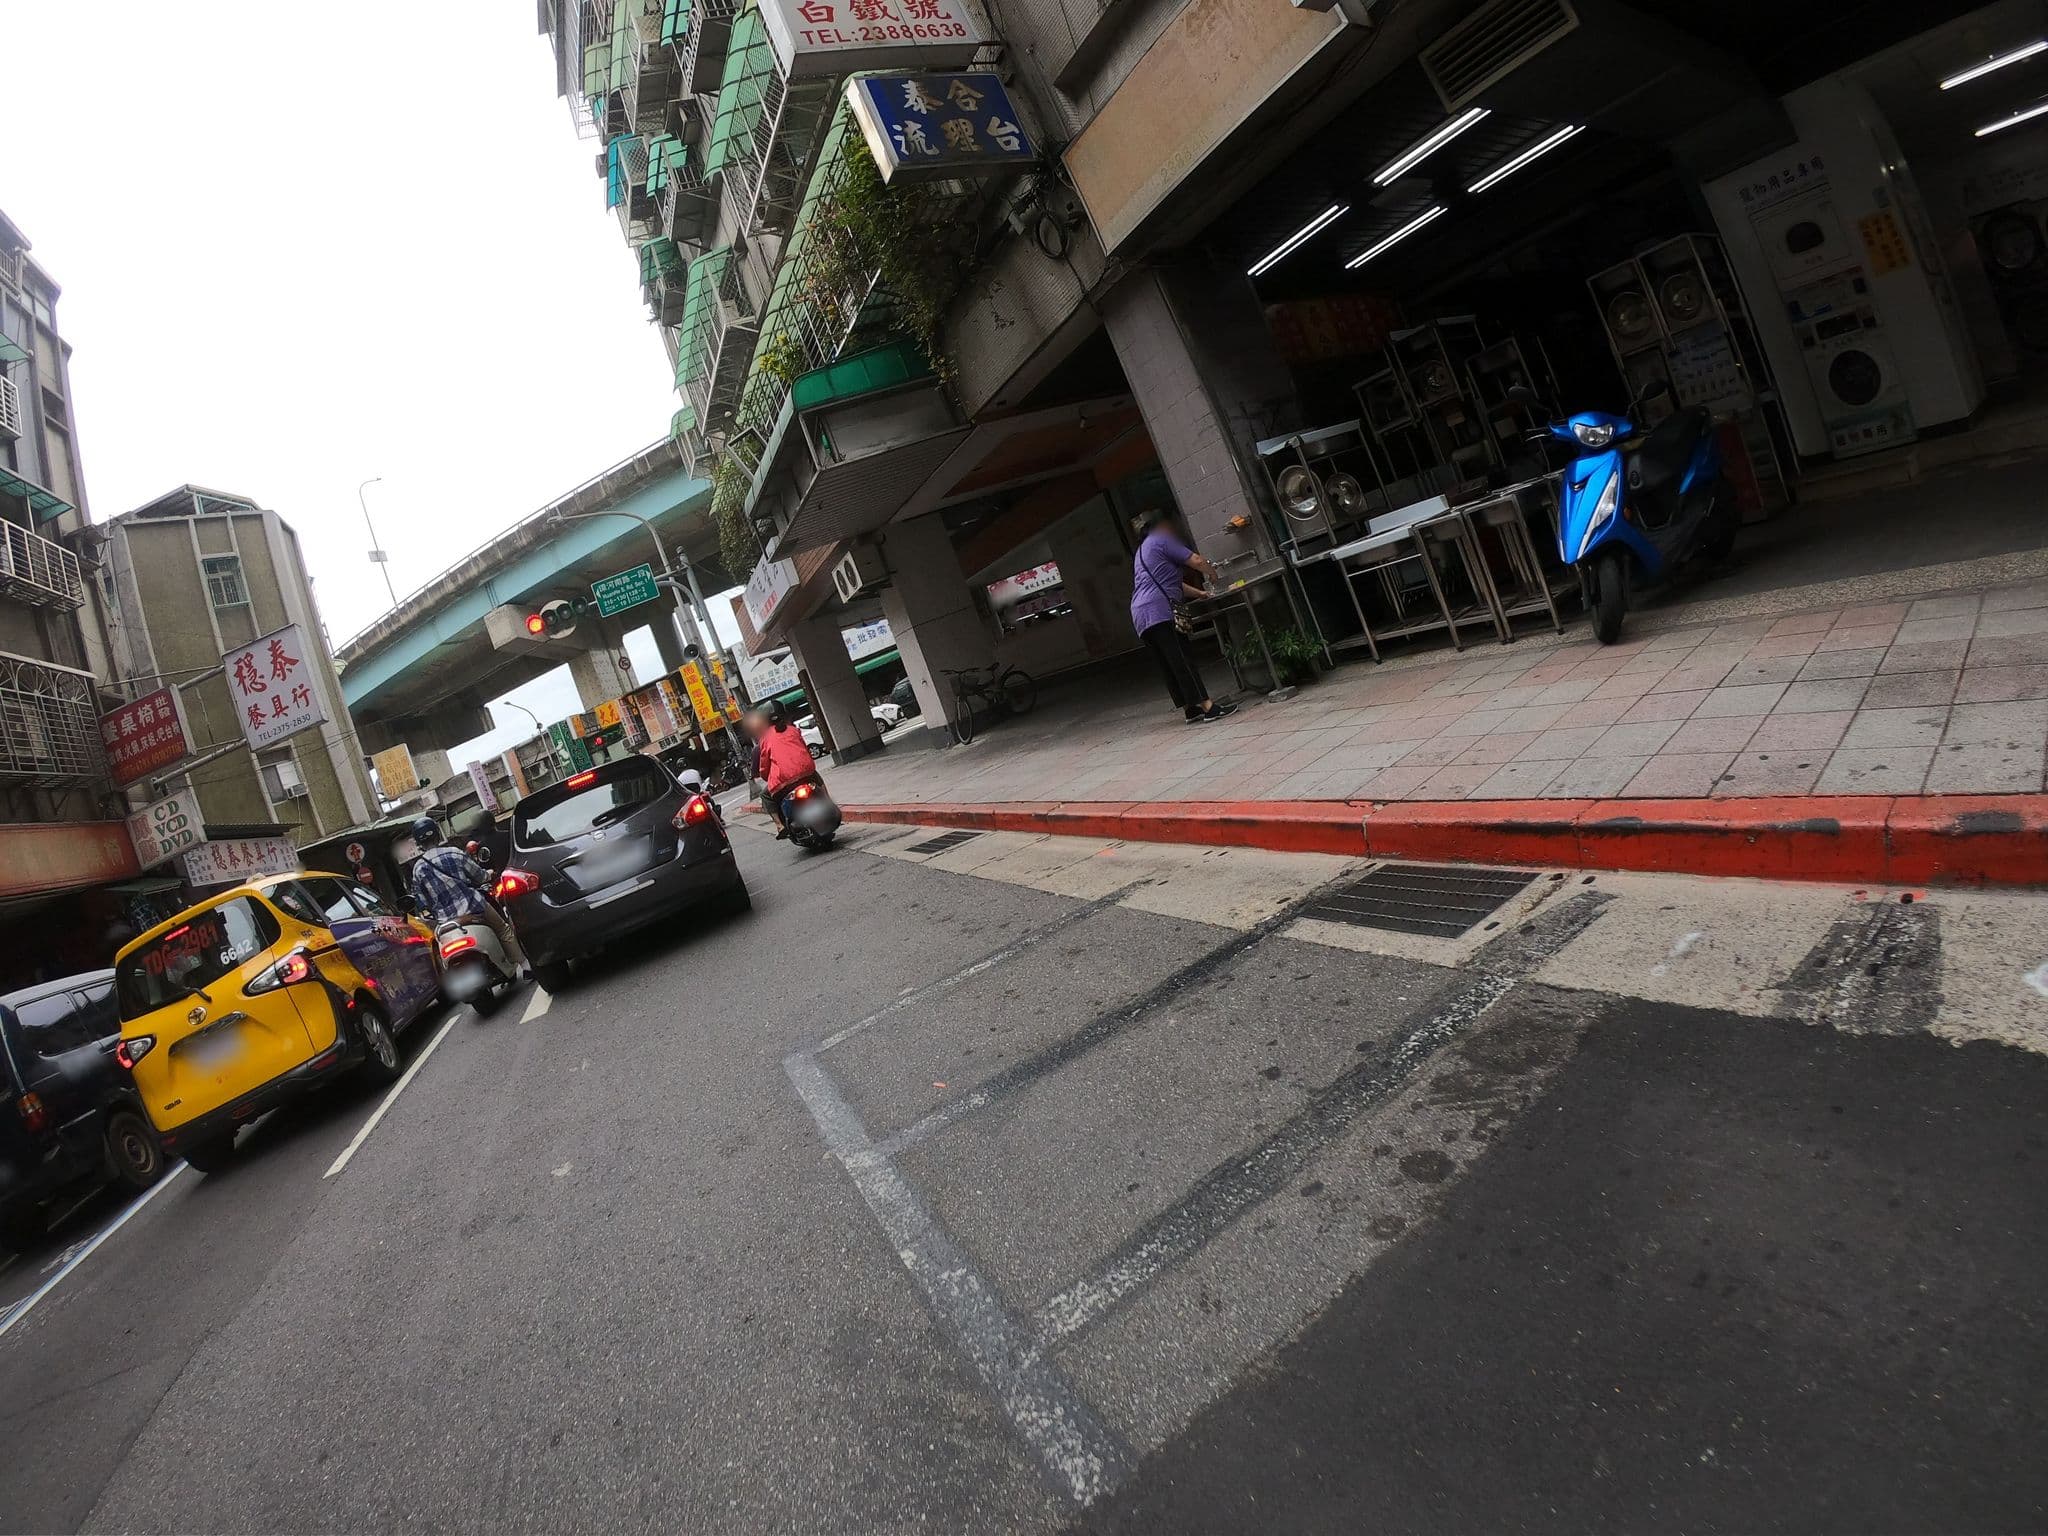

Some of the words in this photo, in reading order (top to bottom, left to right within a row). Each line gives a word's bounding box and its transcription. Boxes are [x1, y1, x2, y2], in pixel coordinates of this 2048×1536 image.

[800, 22, 967, 45] TEL:23886638
[892, 116, 1021, 156] 流理台
[233, 639, 299, 697] 穩泰
[247, 684, 311, 731] 餐具行
[154, 801, 180, 820] CD
[154, 814, 188, 837] VCD
[160, 829, 194, 854] DVD
[220, 939, 254, 967] 6642
